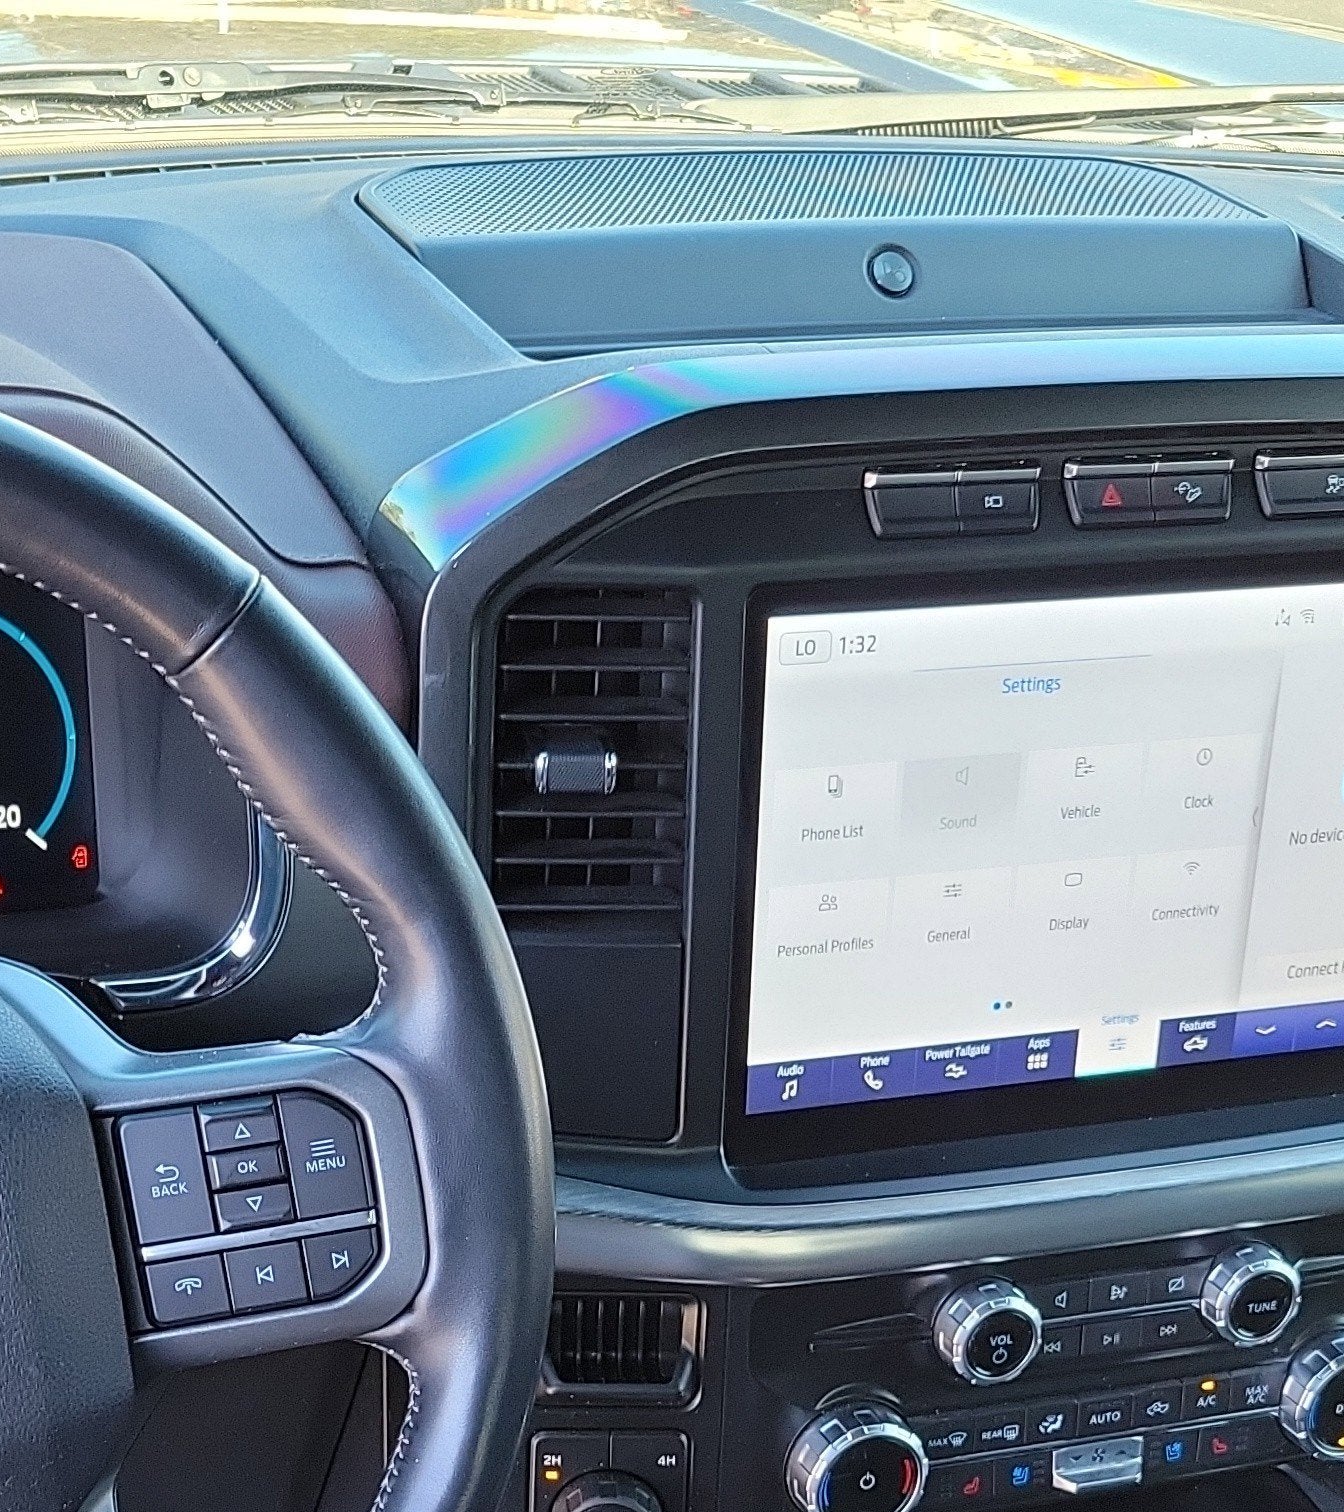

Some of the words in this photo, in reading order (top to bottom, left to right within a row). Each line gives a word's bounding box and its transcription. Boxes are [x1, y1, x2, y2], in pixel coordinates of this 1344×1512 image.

[795, 640, 816, 657] LO
[839, 634, 877, 655] 1:32
[1002, 675, 1061, 695] Settings
[1184, 794, 1214, 810] Clock
[1060, 803, 1101, 820] Vehicle
[940, 814, 977, 831] Sound
[801, 825, 840, 842] Phone
[842, 823, 864, 839] List
[1288, 830, 1307, 845] No
[1152, 903, 1220, 921] Connectivity
[1049, 916, 1090, 933] Display
[927, 927, 971, 943] General
[777, 940, 828, 958] Personal
[831, 936, 874, 954] Profiles
[1287, 961, 1339, 980] Connect
[1101, 1012, 1139, 1027] Settings
[1178, 1018, 1217, 1033] Features
[1028, 1037, 1050, 1051] Apps
[925, 1048, 954, 1062] Power
[955, 1043, 991, 1059] Tailgate
[860, 1055, 890, 1069] Phone
[777, 1064, 804, 1078] Audio
[237, 1160, 258, 1174] OK
[306, 1156, 346, 1173] MENU
[151, 1182, 189, 1198] BACK
[1247, 1301, 1277, 1314] TUNE
[989, 1334, 1013, 1347] VOL
[1244, 1384, 1269, 1397] MAX
[1197, 1395, 1216, 1408] A/C
[1247, 1393, 1267, 1405] A/C
[1089, 1410, 1121, 1425] AUTO
[982, 1429, 1002, 1440] REAR
[543, 1455, 562, 1466] 2H
[657, 1455, 676, 1466] 4H
